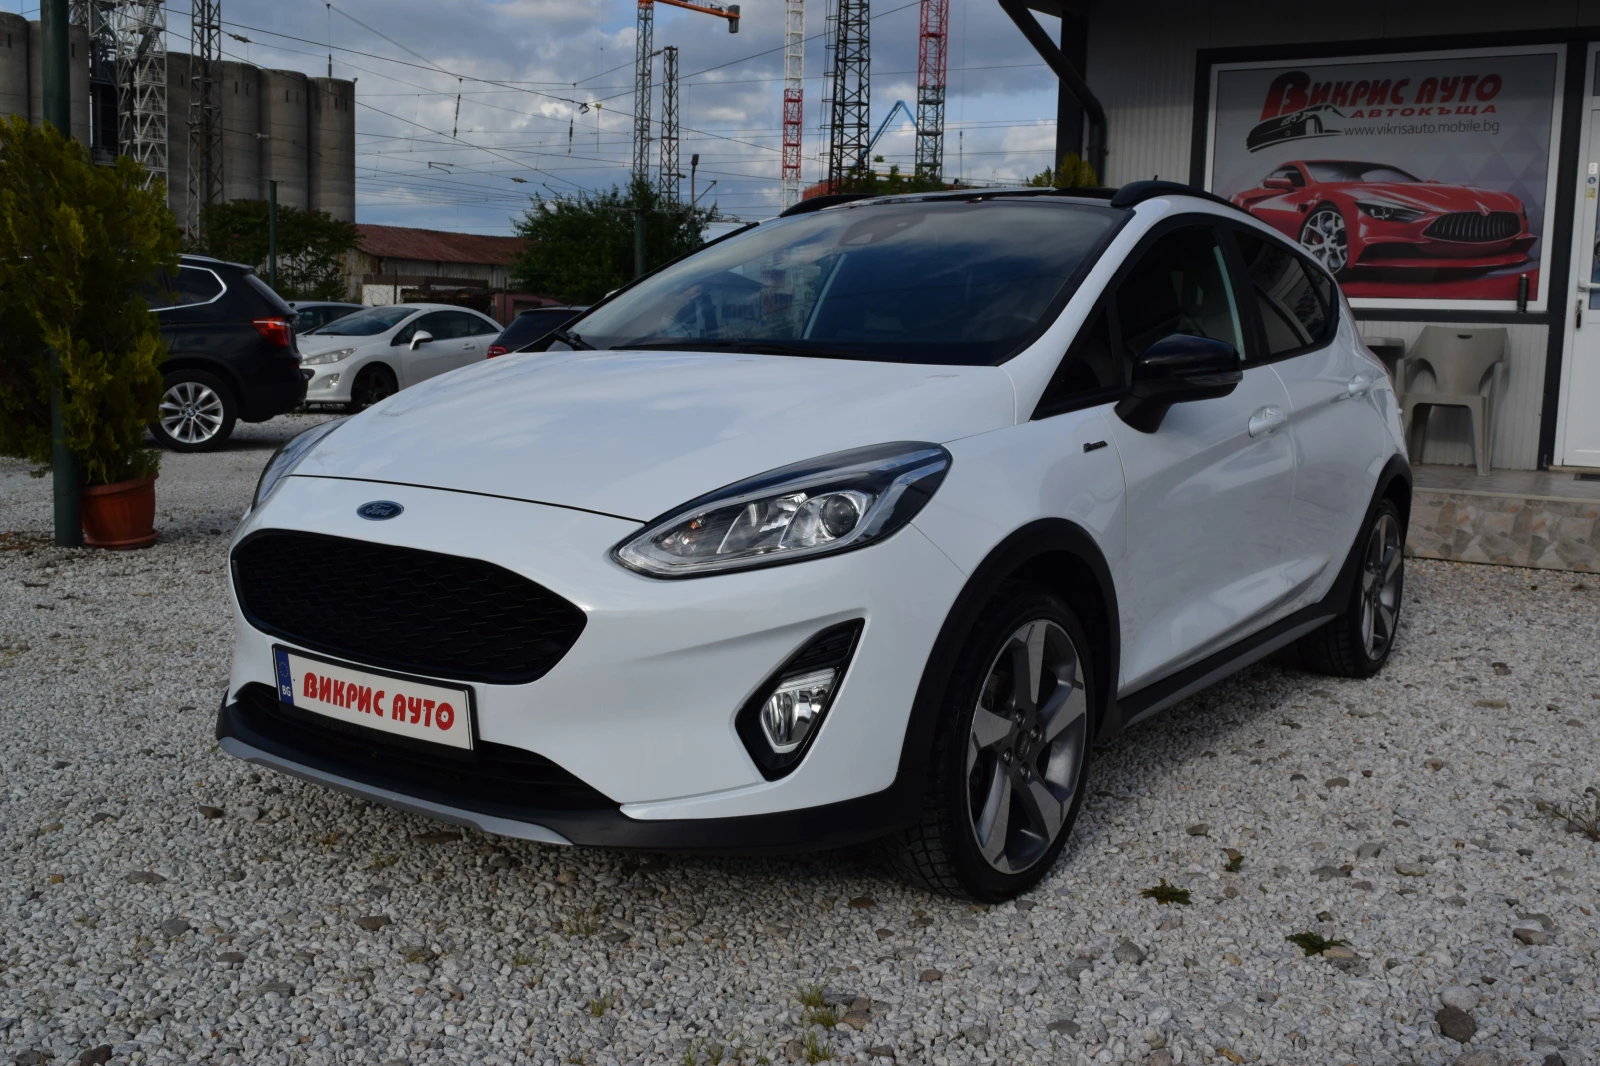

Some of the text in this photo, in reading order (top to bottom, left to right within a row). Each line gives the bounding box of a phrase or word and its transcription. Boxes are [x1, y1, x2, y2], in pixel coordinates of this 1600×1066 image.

[1416, 73, 1503, 105] АУТО
[1349, 103, 1497, 119] АВТОКЪЩА
[1344, 119, 1500, 136] www.vikrisauto.mobile.bg
[281, 685, 292, 697] BG
[303, 672, 455, 731] ВИКРИС АУТО
